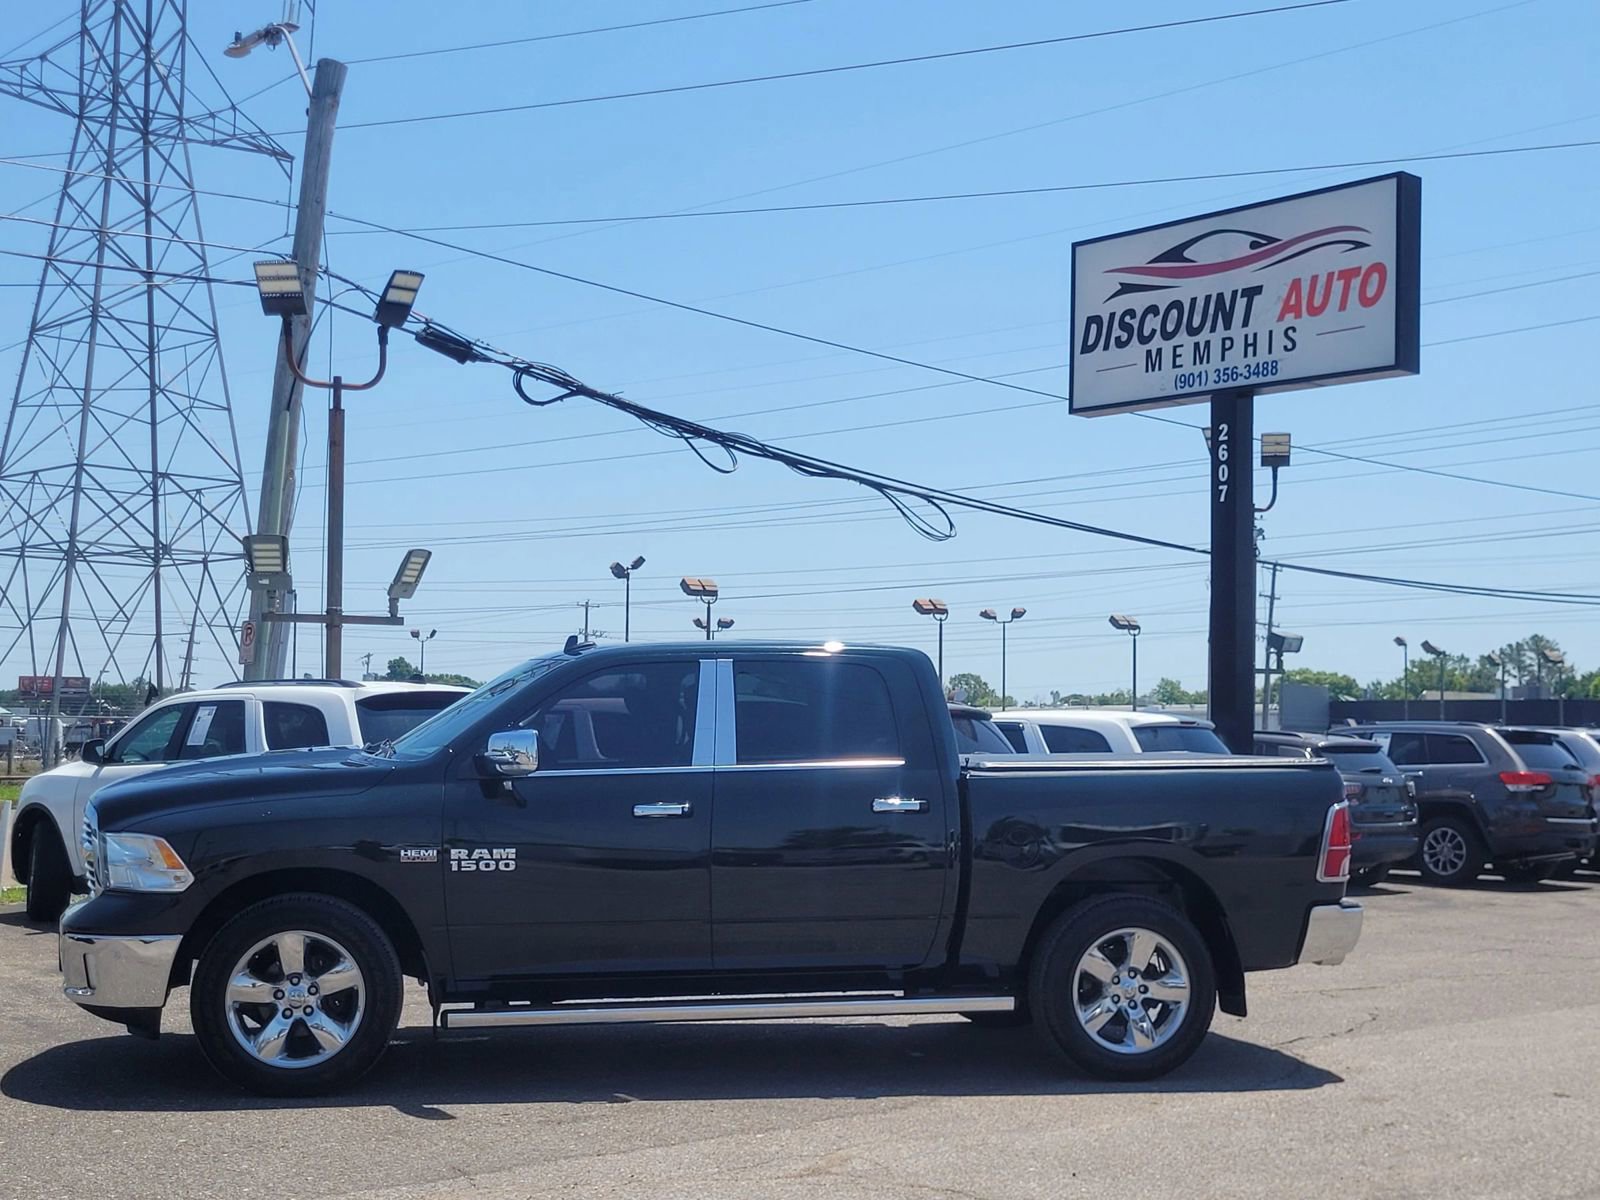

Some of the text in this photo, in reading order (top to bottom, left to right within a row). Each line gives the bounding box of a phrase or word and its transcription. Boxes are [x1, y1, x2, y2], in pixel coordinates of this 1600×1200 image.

[1080, 262, 1387, 354] DISCOUNT AUTO
[1145, 326, 1297, 373] MEMPHIS
[1174, 360, 1279, 391] (901) 356-3488
[1218, 423, 1229, 503] 2607
[401, 849, 437, 857] HEMI
[450, 848, 516, 860] RAM
[450, 860, 516, 871] 1500
